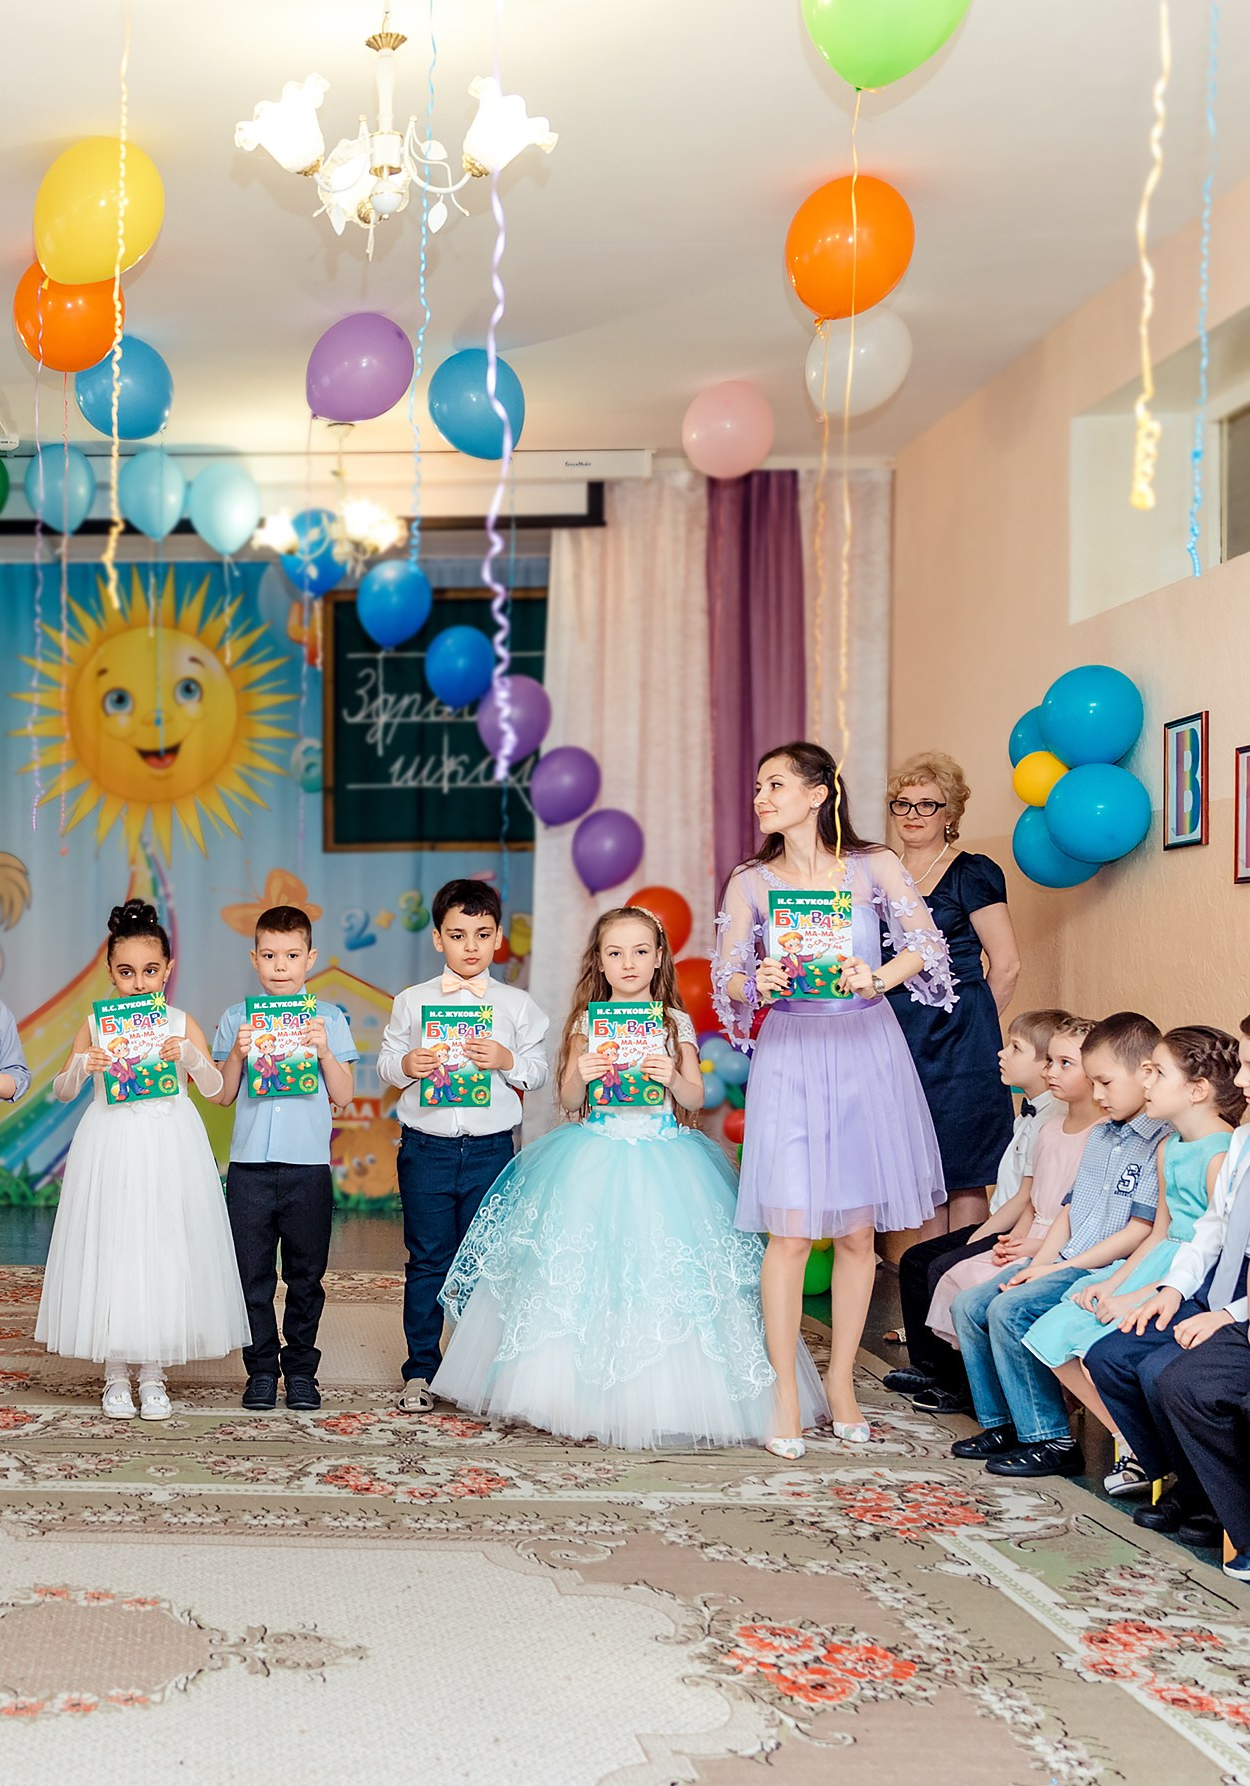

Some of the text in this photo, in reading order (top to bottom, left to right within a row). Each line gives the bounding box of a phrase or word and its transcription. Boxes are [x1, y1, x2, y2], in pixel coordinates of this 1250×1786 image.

[340, 907, 377, 952] 2
[100, 1011, 168, 1035] БУКВАРЬ
[426, 1021, 492, 1041] БУКВАРЬ
[593, 1018, 663, 1039] БУКВАРЬ
[1116, 1163, 1141, 1194] S
